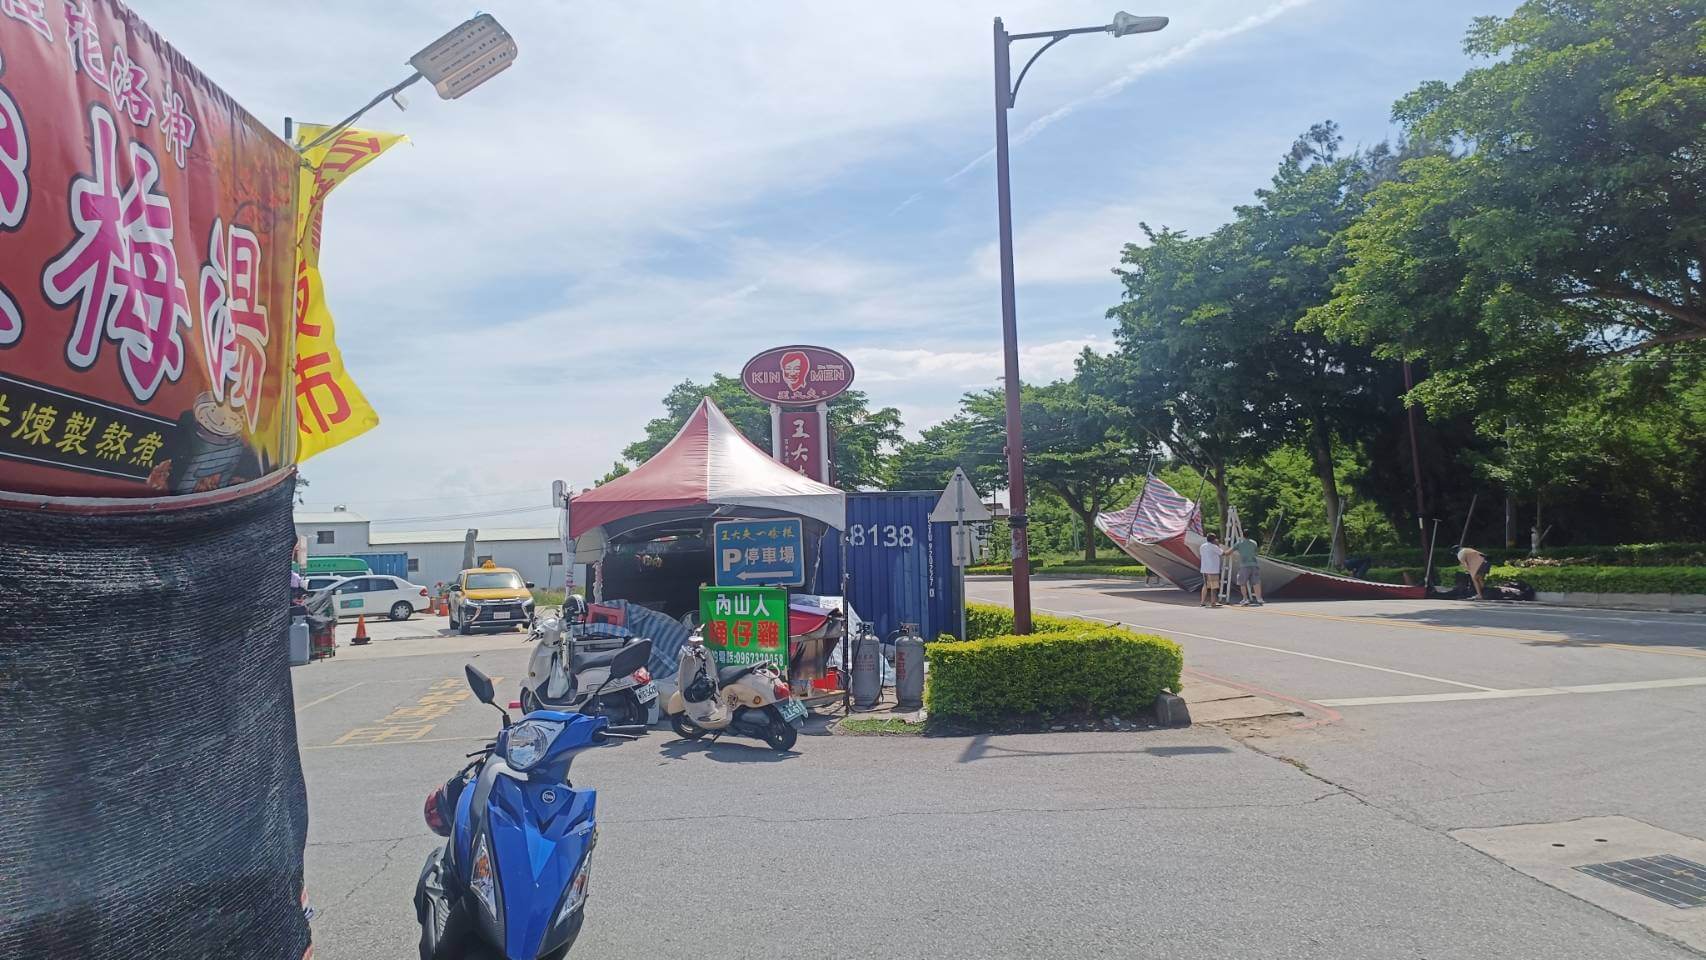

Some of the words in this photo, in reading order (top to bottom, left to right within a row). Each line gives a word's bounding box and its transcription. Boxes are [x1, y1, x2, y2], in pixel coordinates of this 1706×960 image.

[0, 88, 268, 434] 梅湯
[752, 371, 780, 383] KIN
[810, 369, 845, 381] MEN
[850, 523, 914, 547] 8138
[745, 546, 795, 566] 停車場
[716, 592, 770, 617] 內山人
